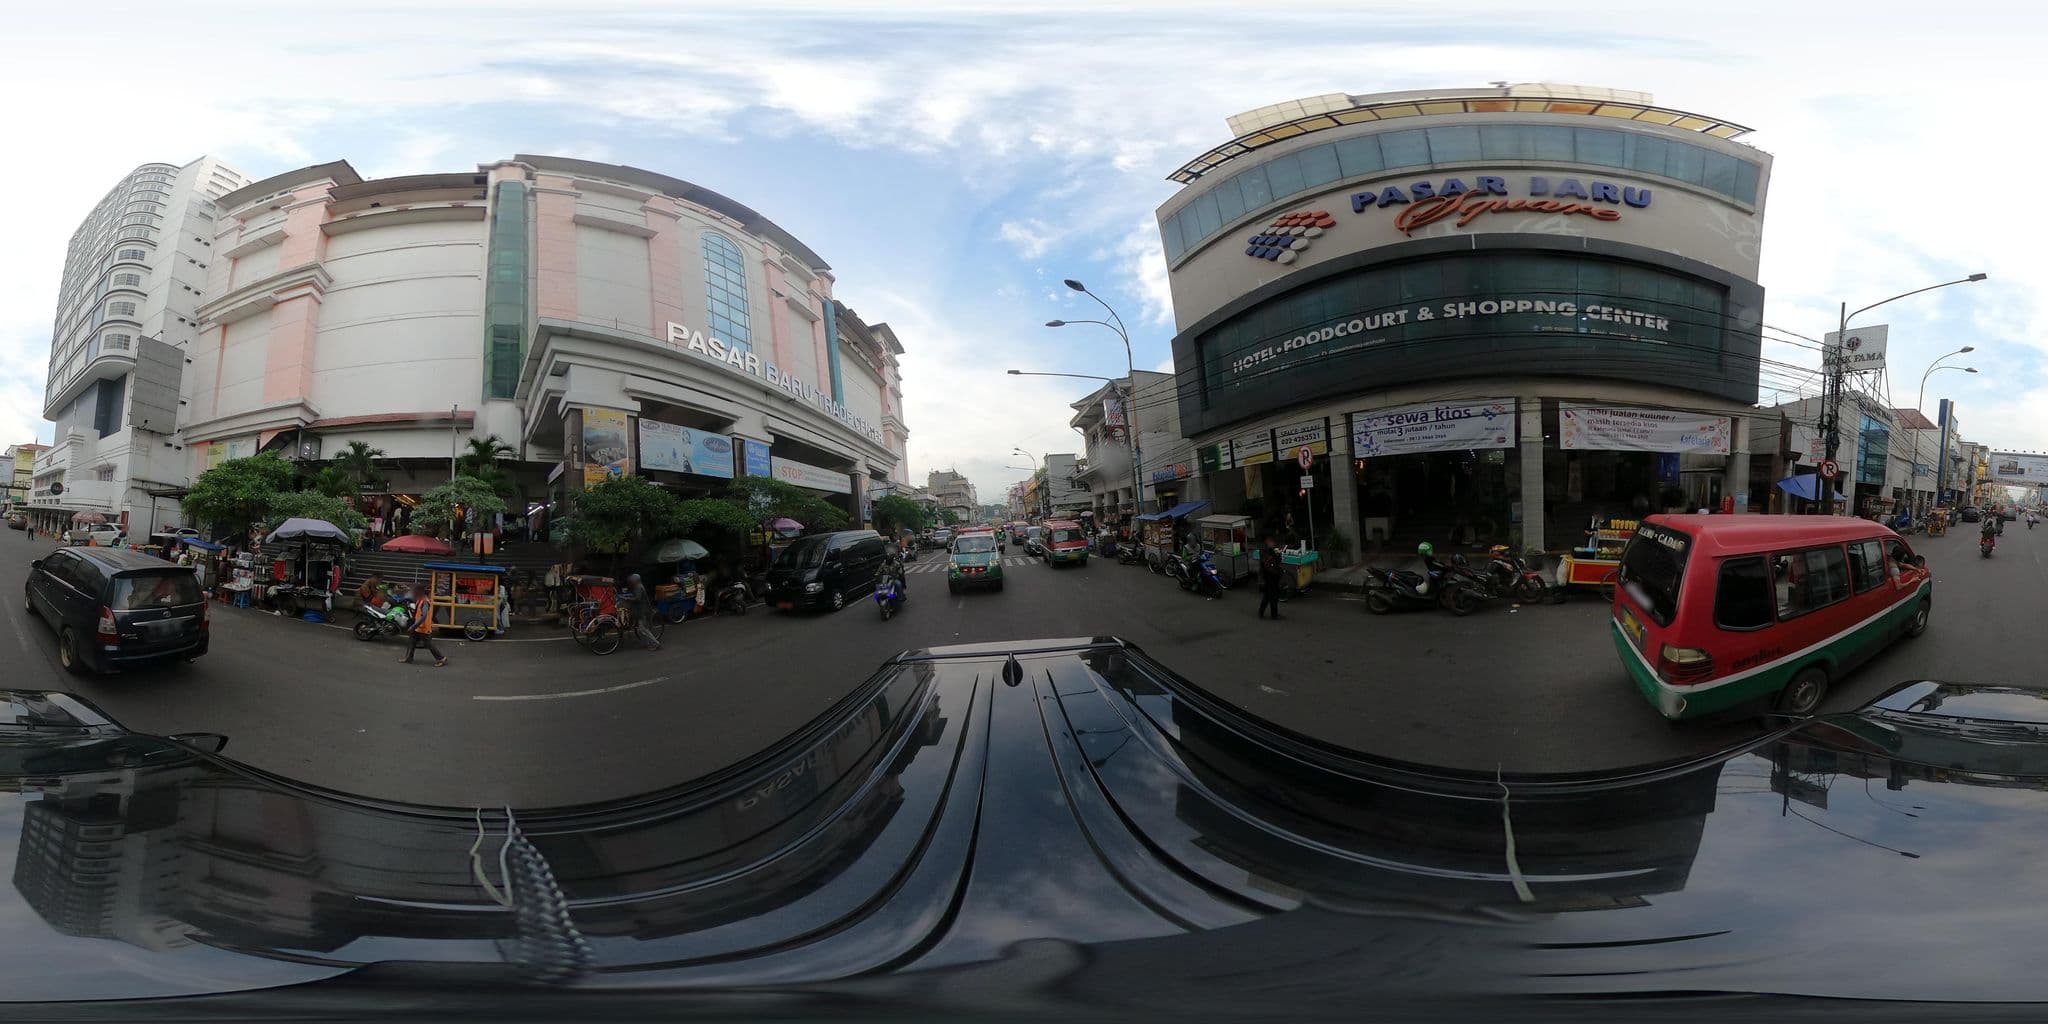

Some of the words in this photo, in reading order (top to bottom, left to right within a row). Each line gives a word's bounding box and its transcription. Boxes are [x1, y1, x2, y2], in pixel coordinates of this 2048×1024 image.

[1350, 176, 1508, 213] PASAR
[1394, 188, 1622, 237] Square
[1233, 345, 1277, 373] HOTEL
[1283, 310, 1408, 354] FOODCOURT
[1417, 306, 1435, 321] &
[1443, 300, 1577, 317] SHOPPNG
[1585, 304, 1669, 332] CENTER
[666, 320, 760, 377] PASAR
[765, 361, 811, 399] BARU
[815, 389, 852, 423] TRADE
[853, 416, 883, 442] CENTER
[1387, 411, 1429, 426] sewa
[1435, 406, 1472, 421] kios
[1609, 409, 1638, 418] jualan
[1398, 427, 1403, 436] 3
[1404, 424, 1427, 434] jutaan
[1434, 422, 1456, 431] tahun
[781, 465, 802, 480] STOP
